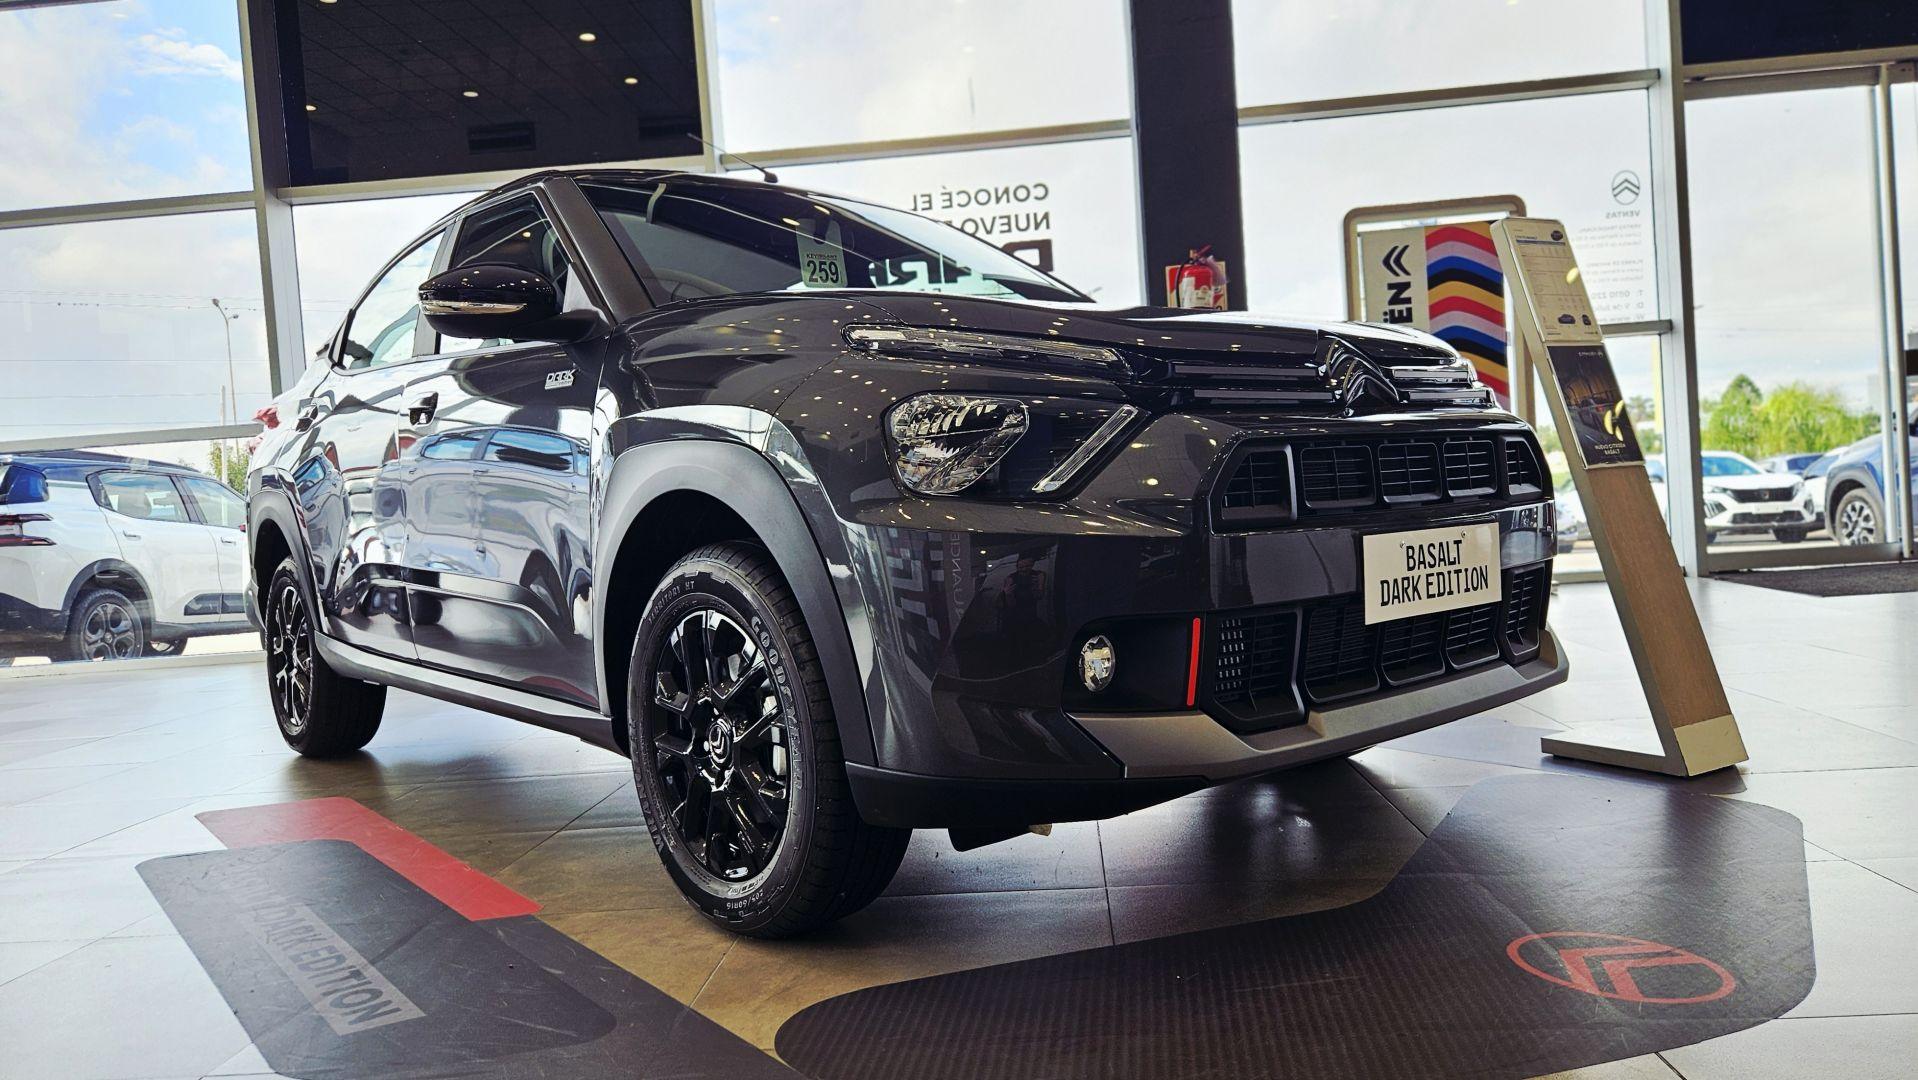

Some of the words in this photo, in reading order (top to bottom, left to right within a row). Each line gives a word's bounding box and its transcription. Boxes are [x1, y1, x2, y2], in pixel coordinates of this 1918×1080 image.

[807, 260, 839, 283] 259
[1406, 540, 1462, 571] BASALT
[1380, 575, 1422, 607] DARK
[1426, 565, 1488, 599] EDITION
[751, 615, 802, 790] GOODYEAR
[287, 944, 403, 1026] EDITION
